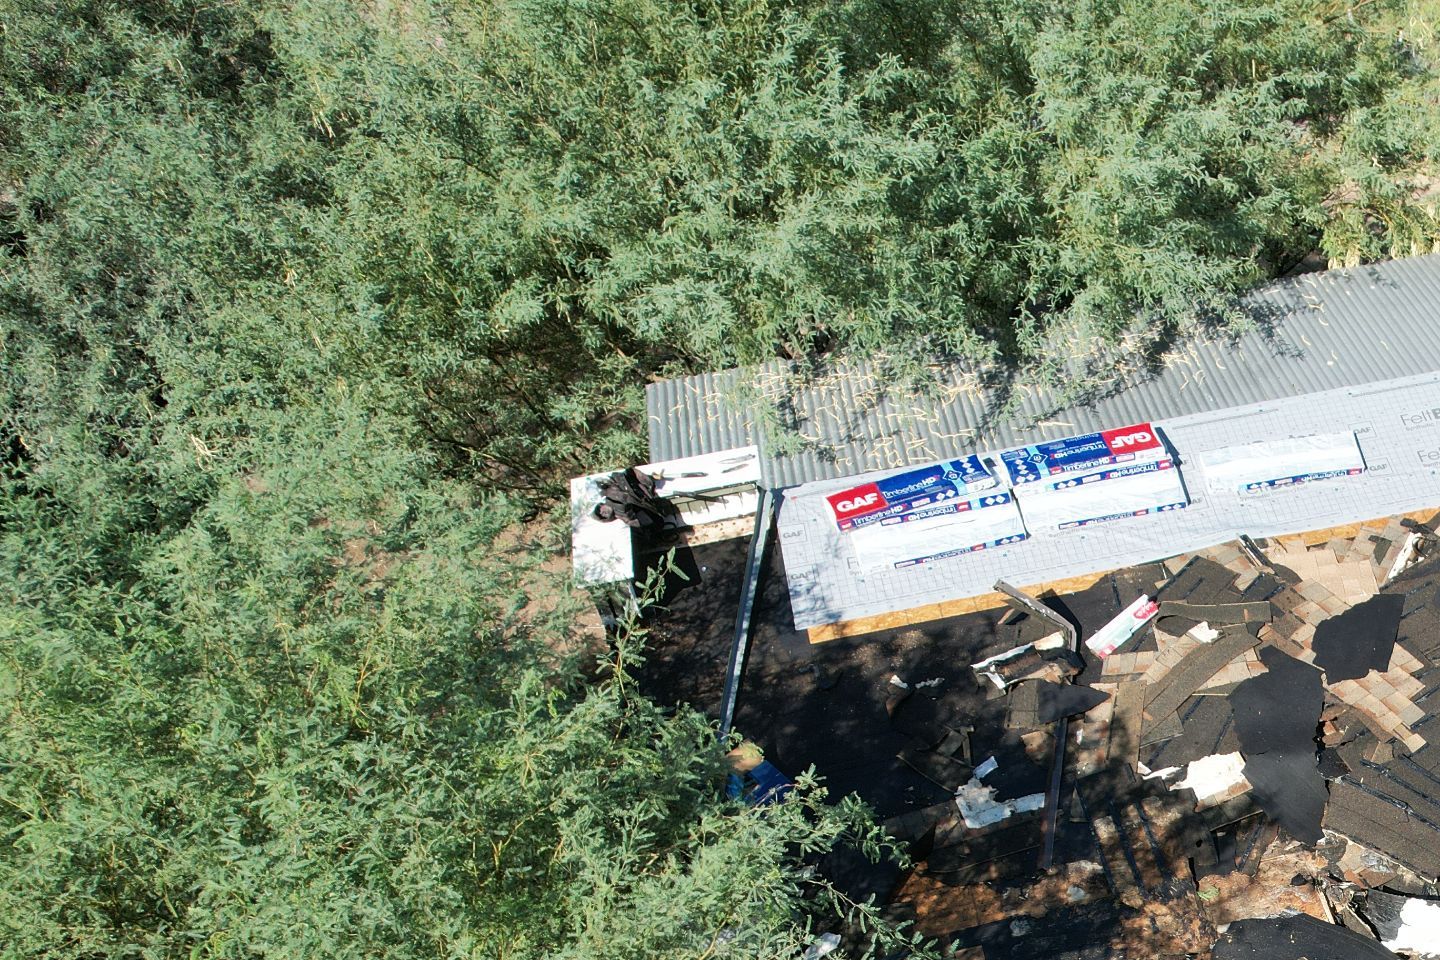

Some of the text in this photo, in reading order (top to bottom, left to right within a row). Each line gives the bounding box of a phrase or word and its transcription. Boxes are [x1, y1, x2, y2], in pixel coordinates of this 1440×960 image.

[1111, 431, 1151, 449] GAF
[1369, 464, 1388, 472] GAF
[836, 492, 878, 513] GAF
[783, 530, 804, 538] GAF
